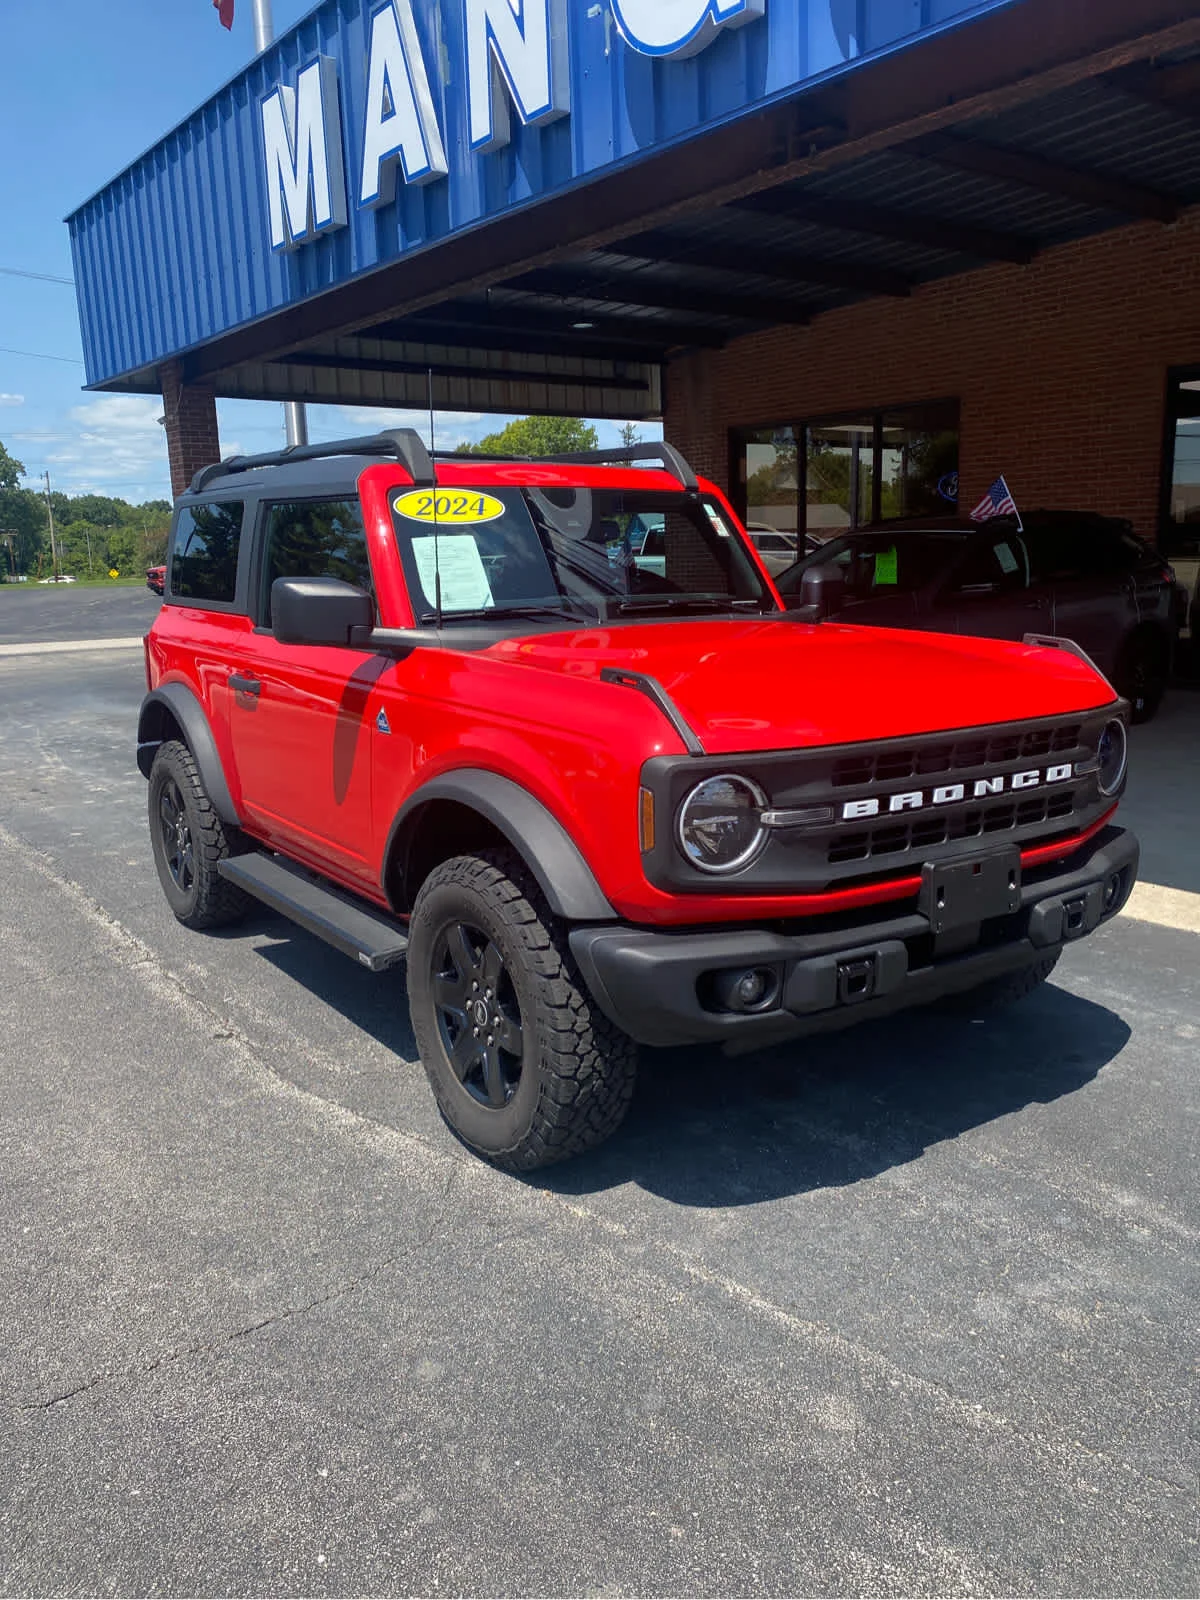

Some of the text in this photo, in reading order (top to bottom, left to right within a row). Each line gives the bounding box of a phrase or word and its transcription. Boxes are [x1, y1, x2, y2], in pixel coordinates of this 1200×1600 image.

[261, 0, 766, 253] MAN
[416, 496, 487, 516] 2024
[843, 763, 1073, 819] BRONCO
